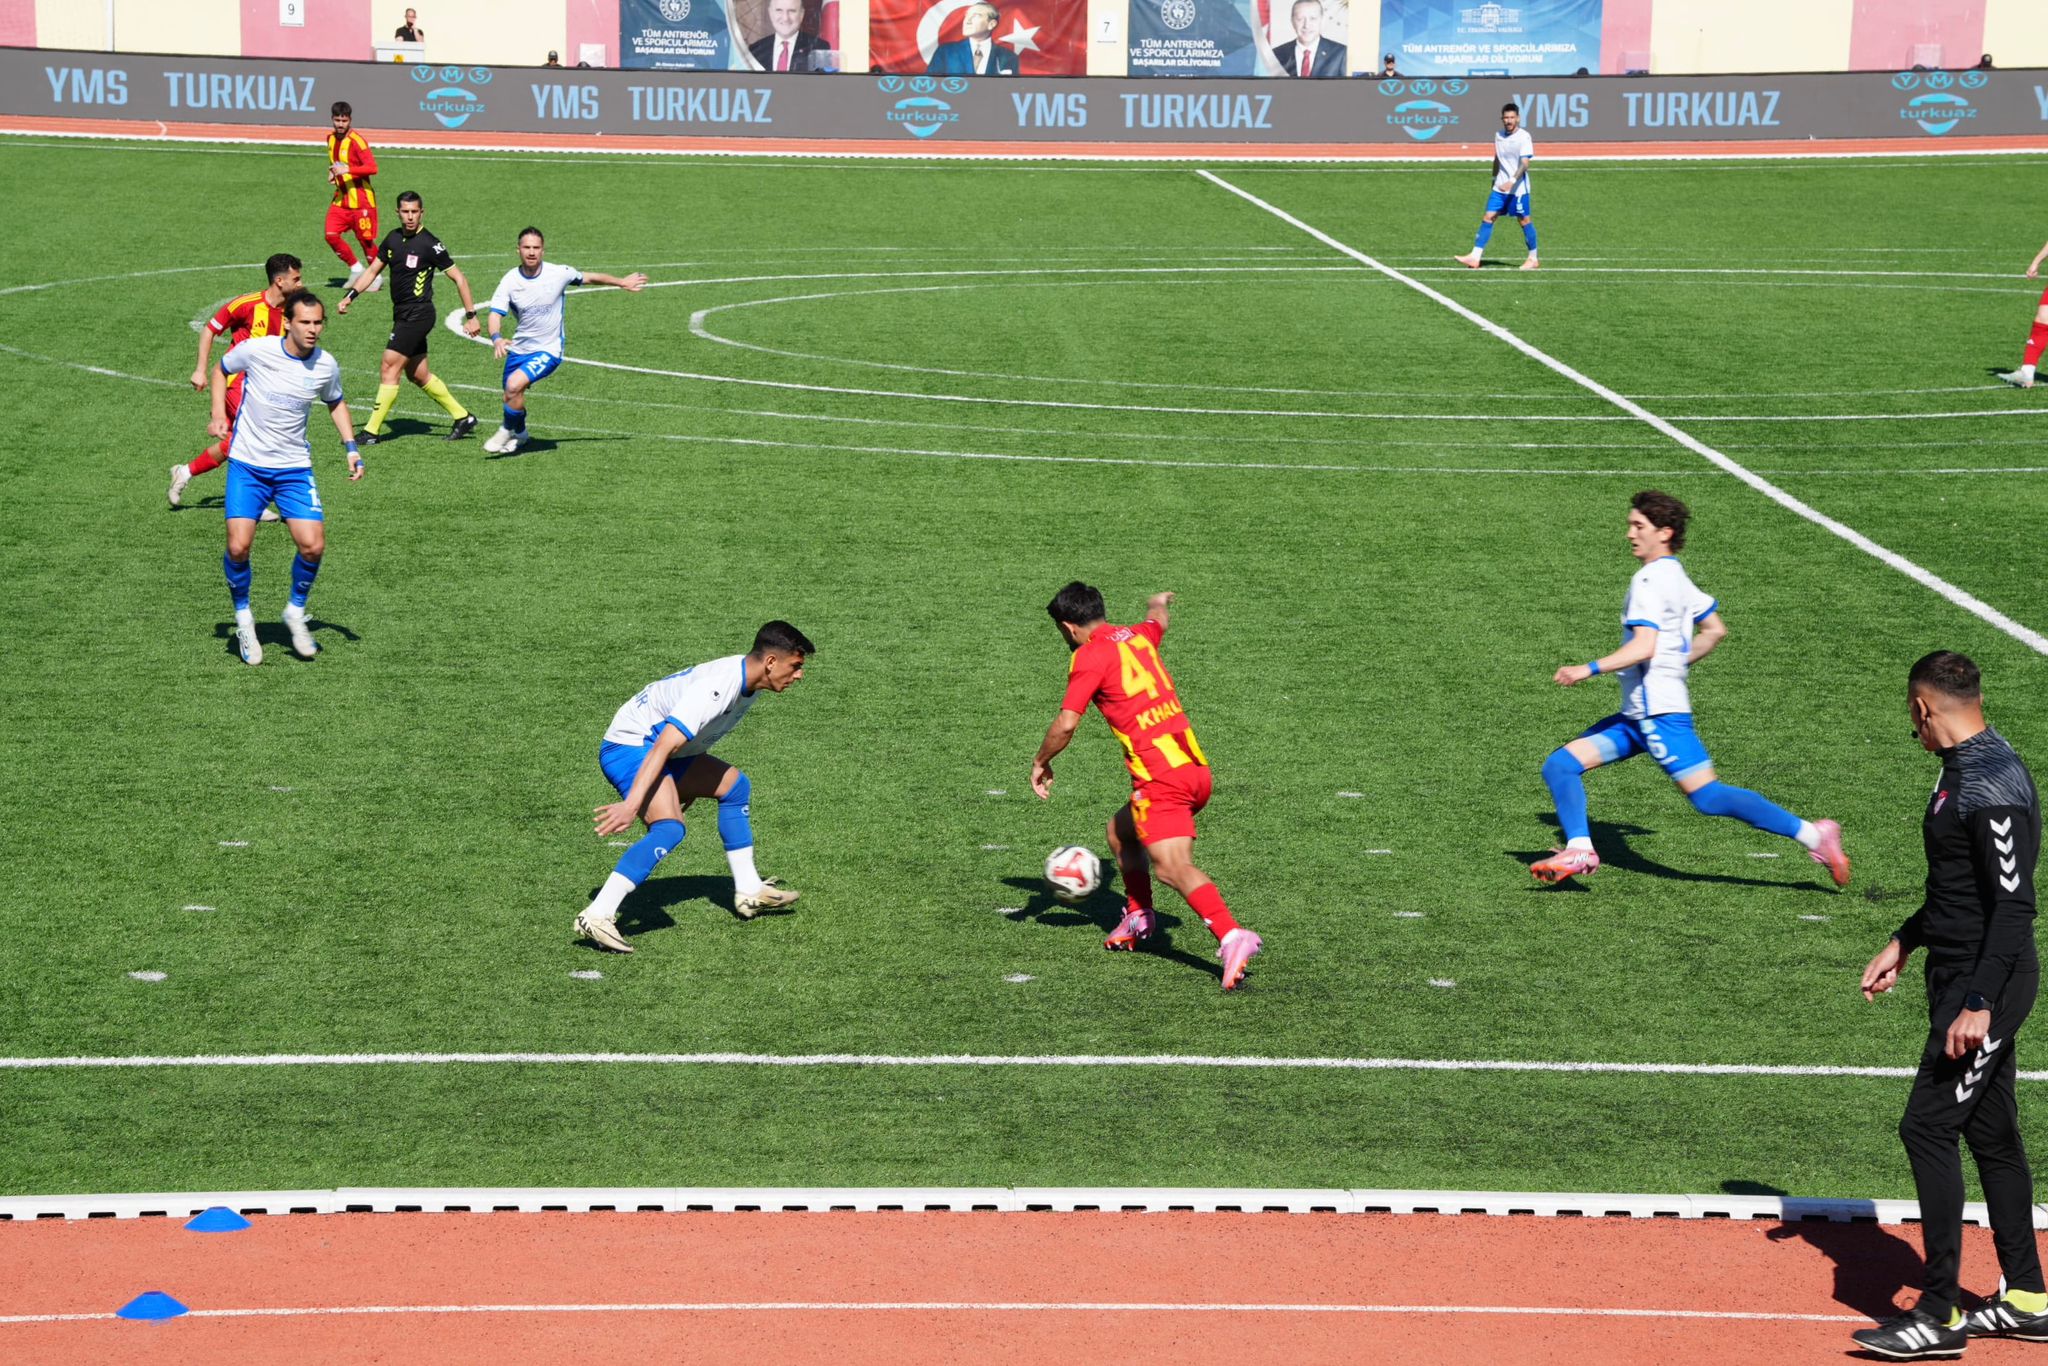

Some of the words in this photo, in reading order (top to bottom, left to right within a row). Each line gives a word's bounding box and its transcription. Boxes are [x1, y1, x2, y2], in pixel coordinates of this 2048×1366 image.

[287, 3, 295, 16] 9
[1103, 21, 1111, 33] 7
[642, 28, 661, 37] TÜM
[662, 30, 708, 39] ANTRENÖR
[631, 37, 644, 46] VE
[1140, 38, 1162, 49] TÜM
[1163, 39, 1215, 49] ANTRENÖR
[1129, 48, 1142, 57] VE
[1402, 42, 1423, 54] TÜM
[1479, 44, 1491, 54] VE
[45, 66, 128, 105] YMS
[163, 72, 316, 112] TURKUAZ
[419, 100, 486, 112] turkuaz
[531, 84, 599, 120] YMS
[628, 86, 773, 123] TURKUAZ
[1512, 92, 1589, 128] YMS
[1623, 90, 1781, 127] TURKUAZ
[886, 111, 960, 122] turkuaz
[1011, 92, 1088, 128] YMS
[1120, 93, 1272, 129] TURKUAZ
[1900, 107, 1978, 119] turkuaz
[1386, 114, 1460, 125] turkuaz
[308, 488, 322, 507] 1
[1116, 633, 1175, 701] 47
